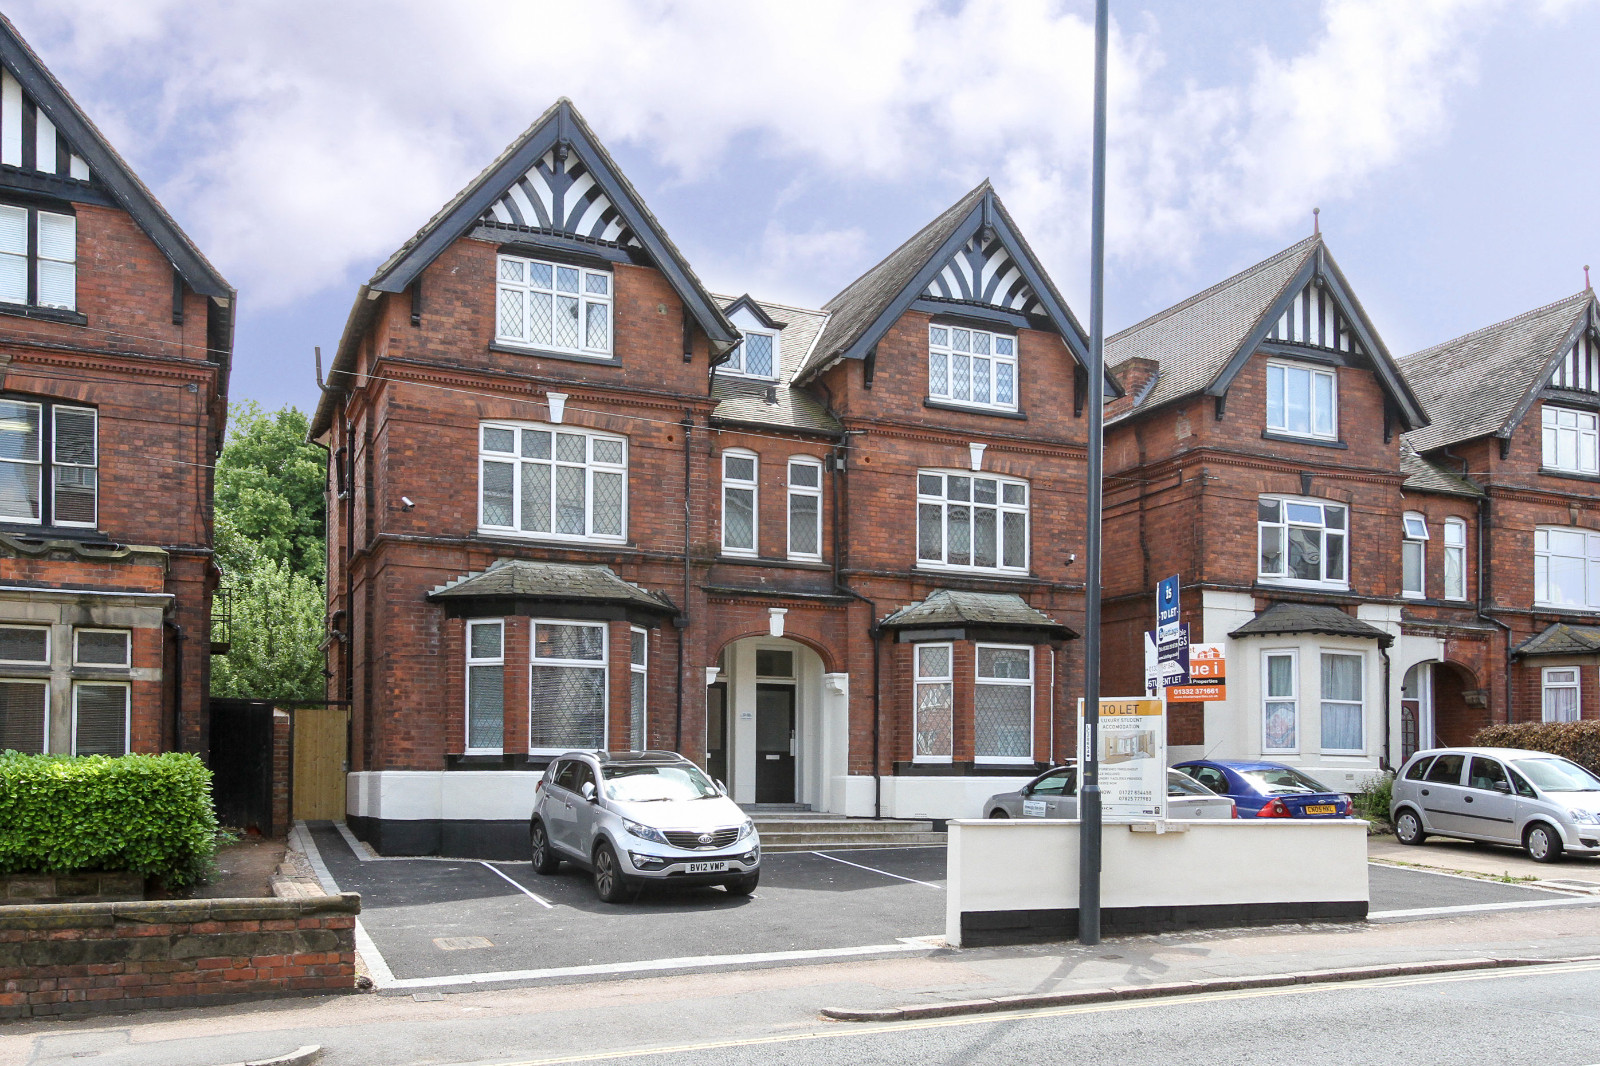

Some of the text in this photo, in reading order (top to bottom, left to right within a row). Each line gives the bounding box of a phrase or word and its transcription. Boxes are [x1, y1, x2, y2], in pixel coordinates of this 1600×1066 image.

[1165, 586, 1172, 599] is
[1161, 607, 1177, 620] TO LET
[1148, 675, 1182, 688] STUENT LET
[1102, 704, 1140, 714] TO LET
[690, 863, 708, 872] BV12
